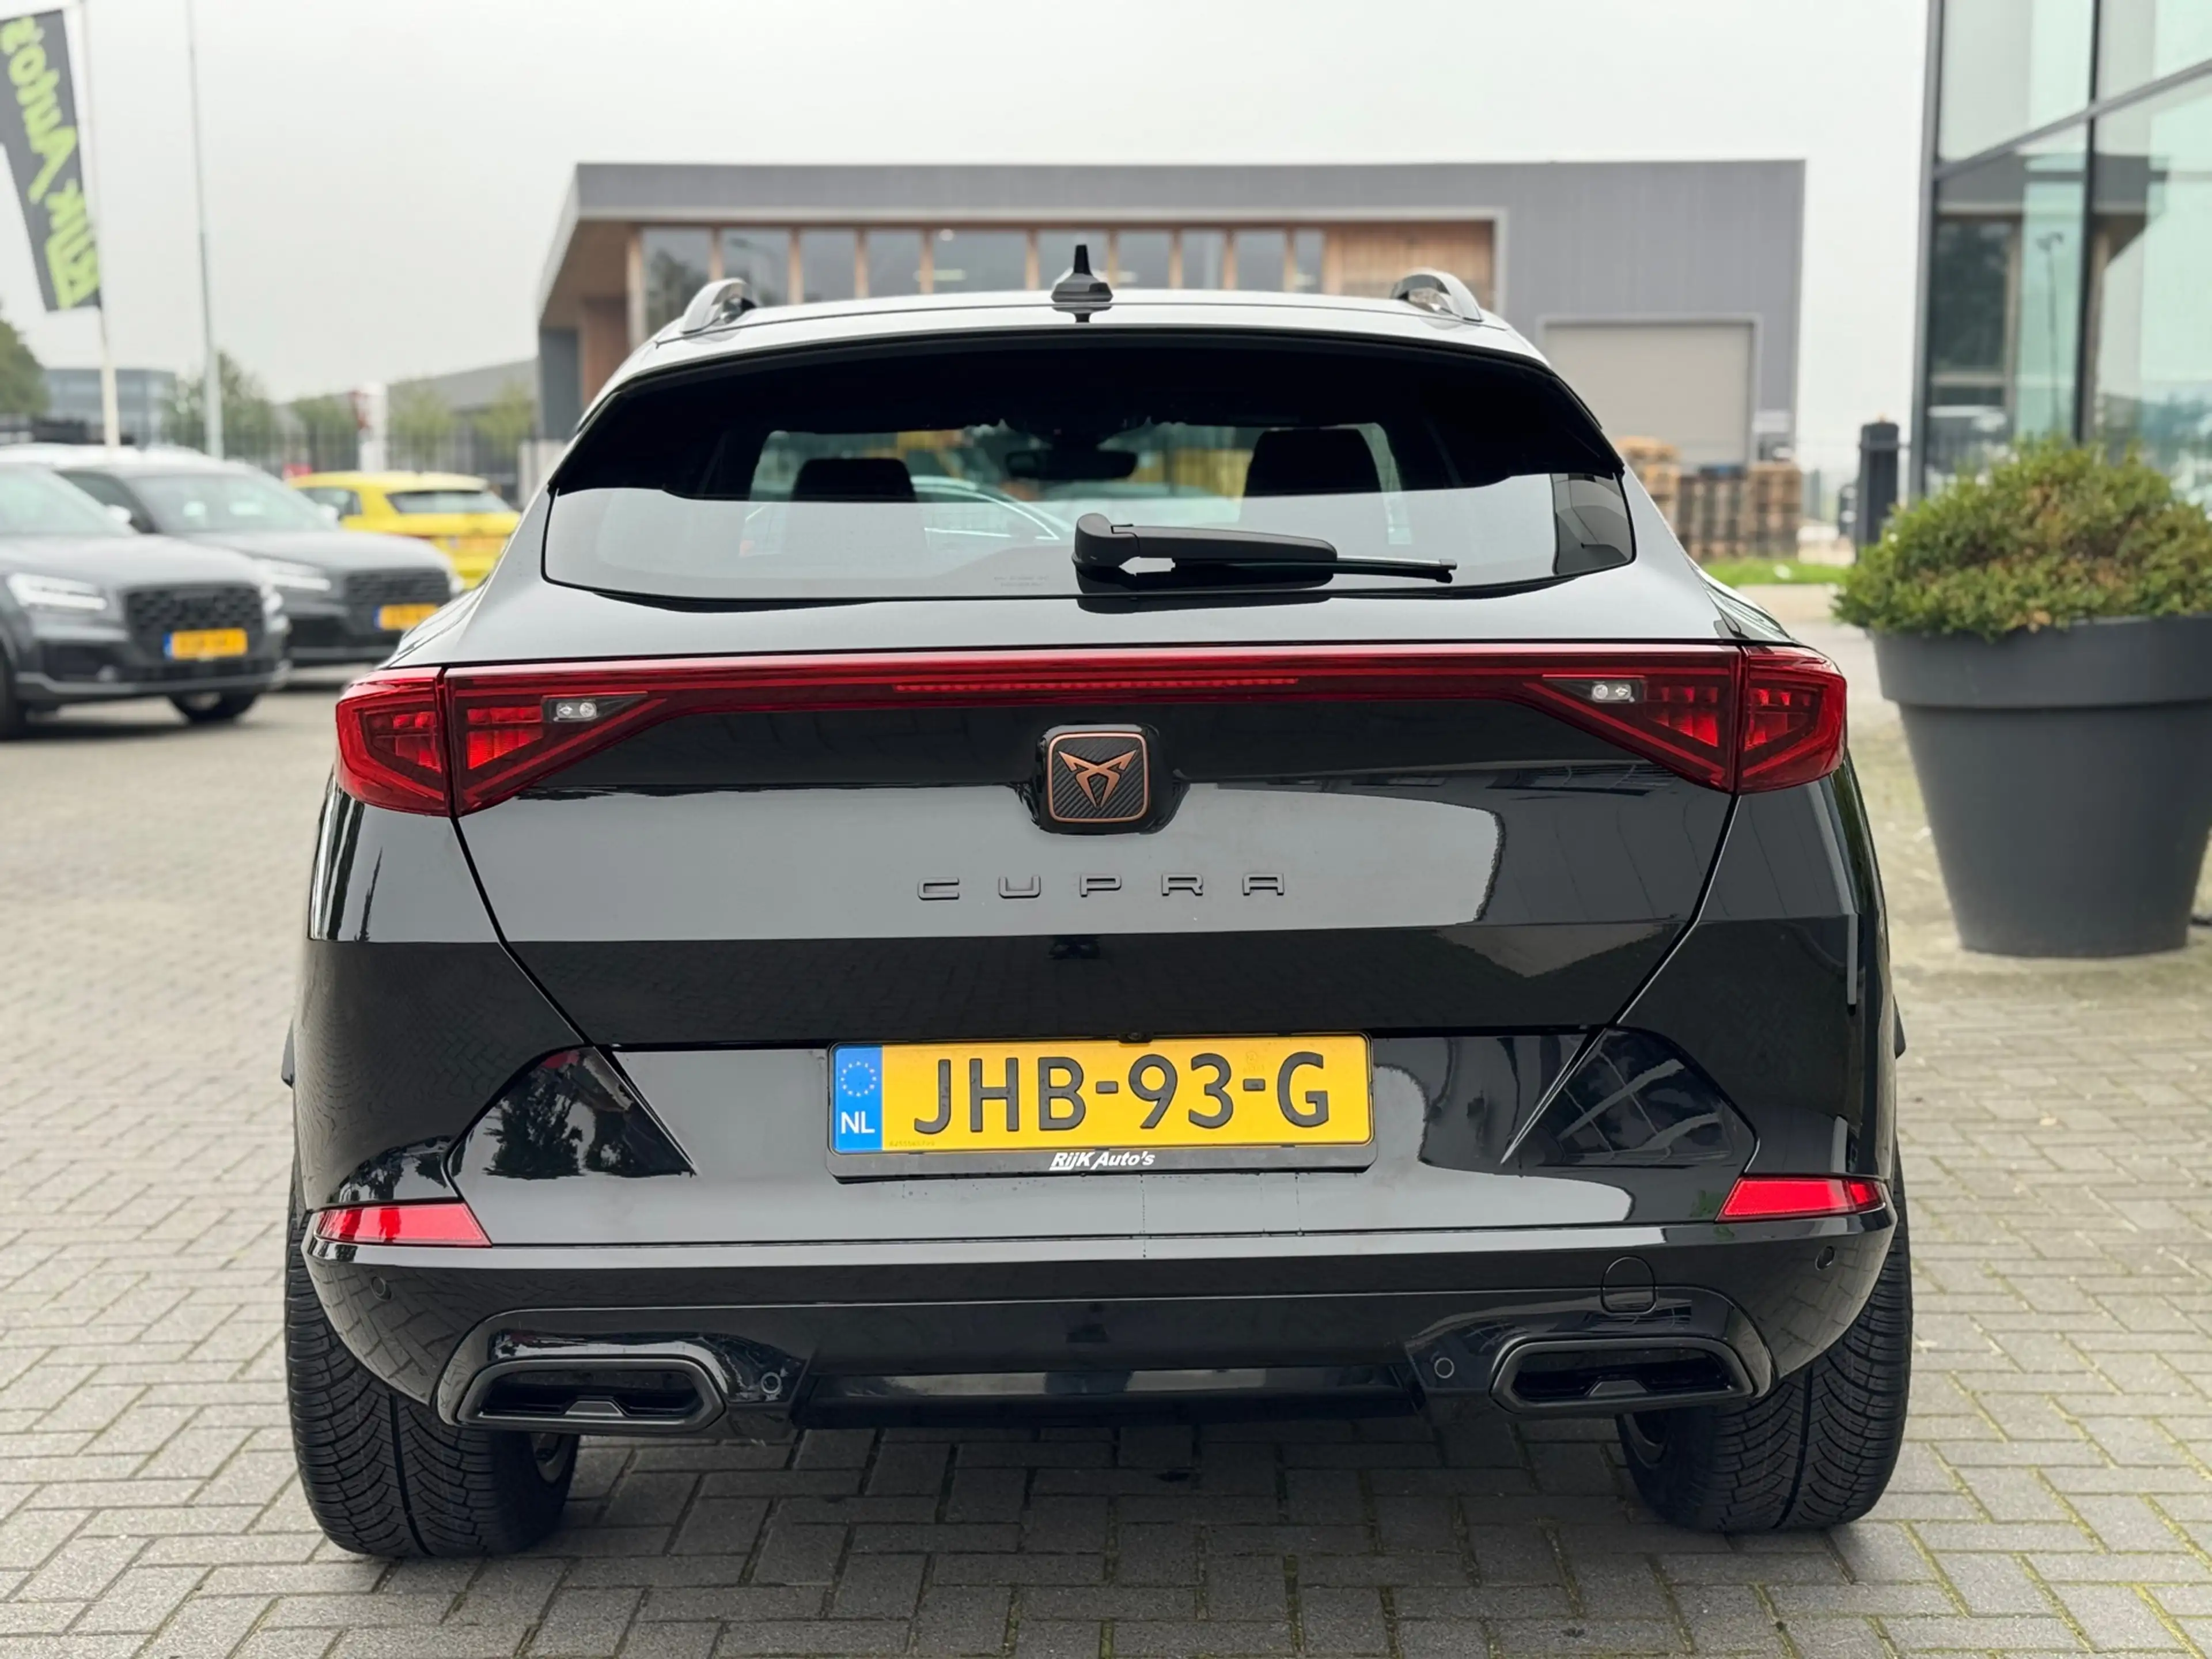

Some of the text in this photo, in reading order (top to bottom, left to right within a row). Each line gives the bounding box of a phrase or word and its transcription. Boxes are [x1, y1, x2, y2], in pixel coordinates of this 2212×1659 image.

[918, 873, 1285, 900] CUPRA
[914, 1052, 1330, 1134] JHB-93-G
[841, 1111, 875, 1135] NL
[1090, 1150, 1156, 1170] Auto's
